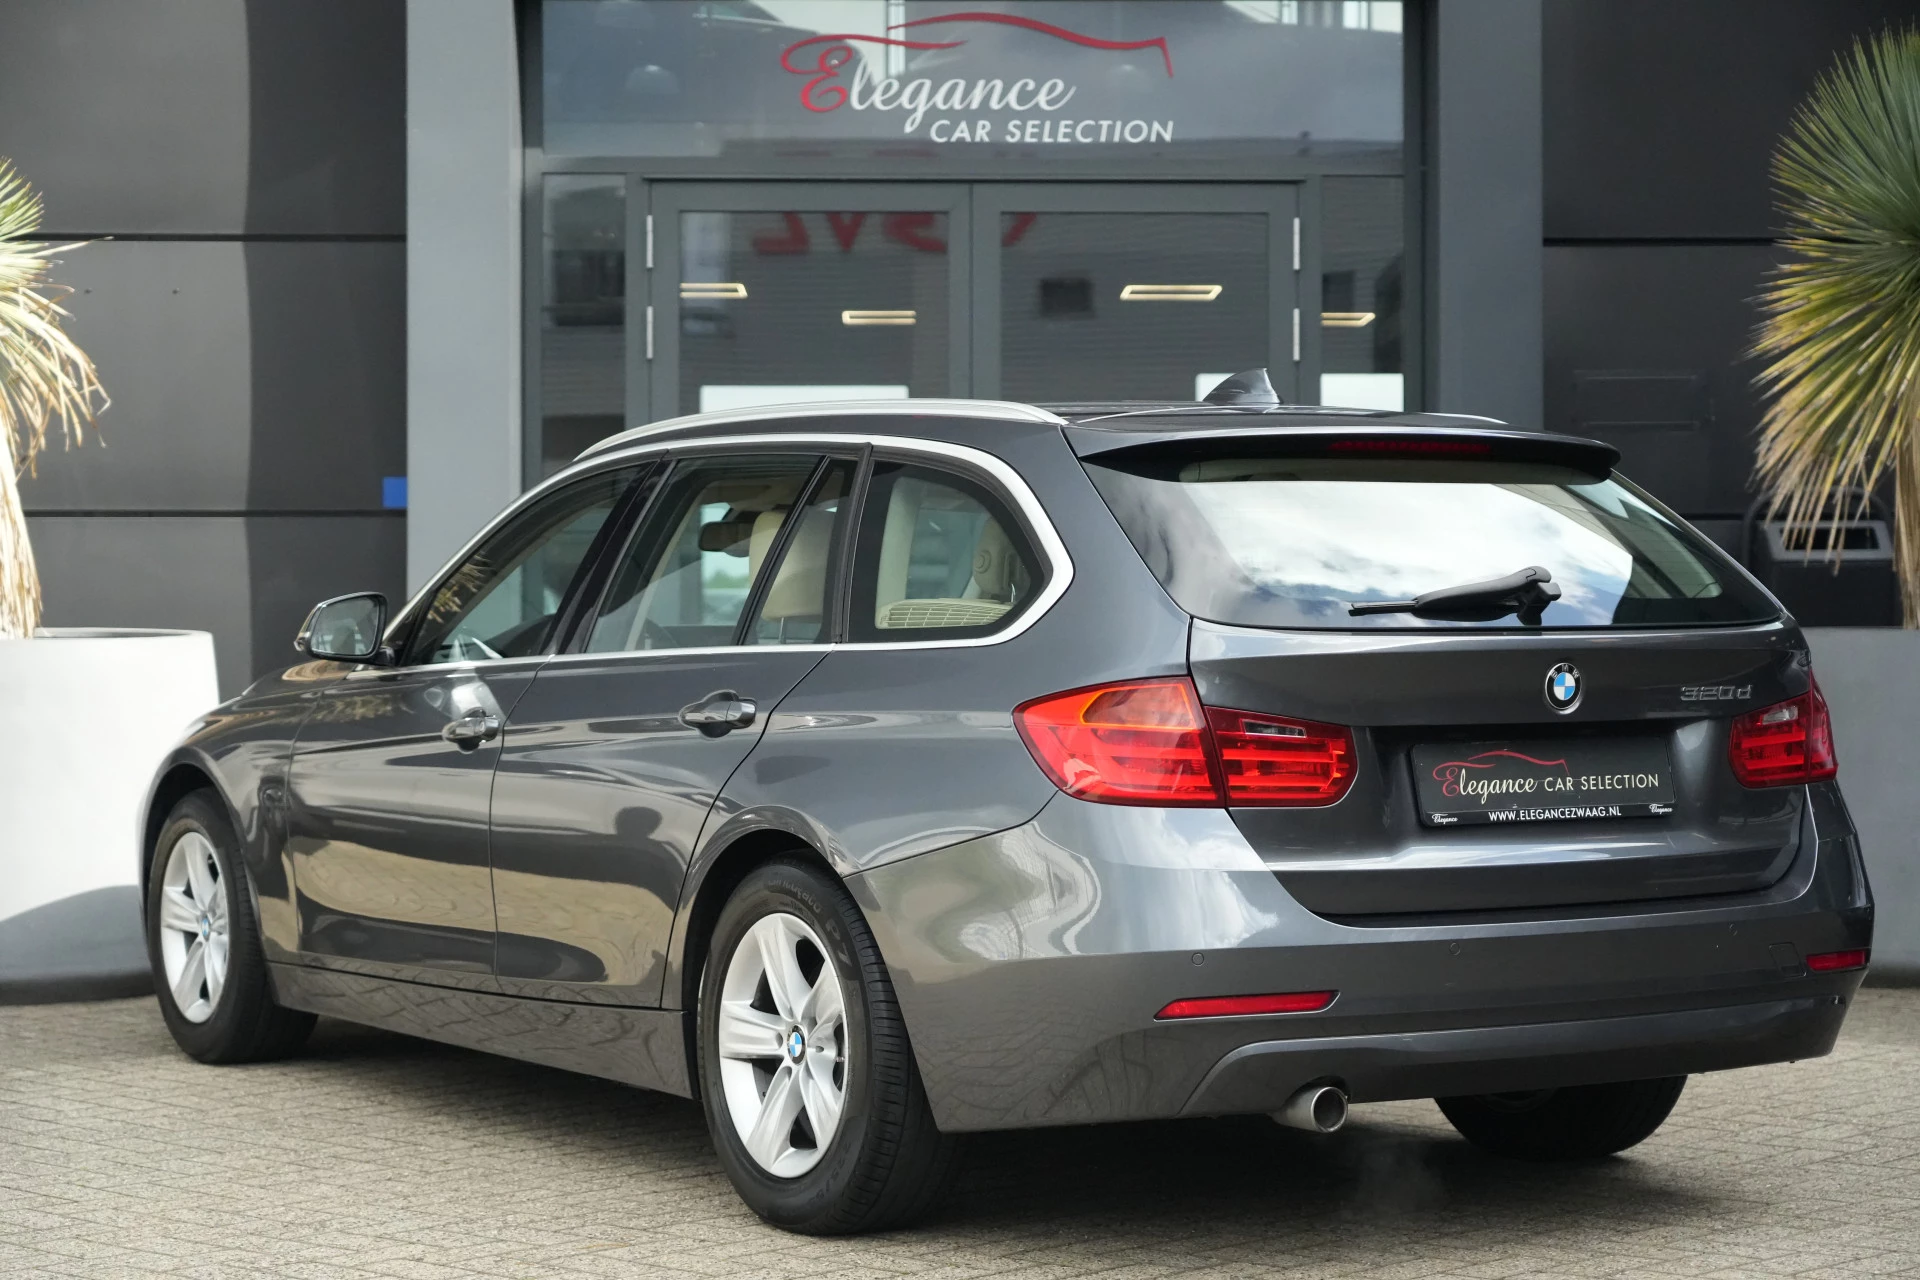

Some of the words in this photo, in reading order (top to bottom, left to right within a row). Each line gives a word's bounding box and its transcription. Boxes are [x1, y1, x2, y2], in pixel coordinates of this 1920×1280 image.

[780, 34, 1077, 134] Elegance
[929, 120, 991, 143] CAR
[1005, 120, 1174, 143] SELECTION
[1680, 684, 1753, 701] 320d
[1432, 761, 1538, 804] Elegance
[1544, 776, 1575, 792] CAR
[1580, 773, 1659, 791] SELECTION
[1488, 806, 1622, 822] WWW.ELEGANCEZWAAG.NL
